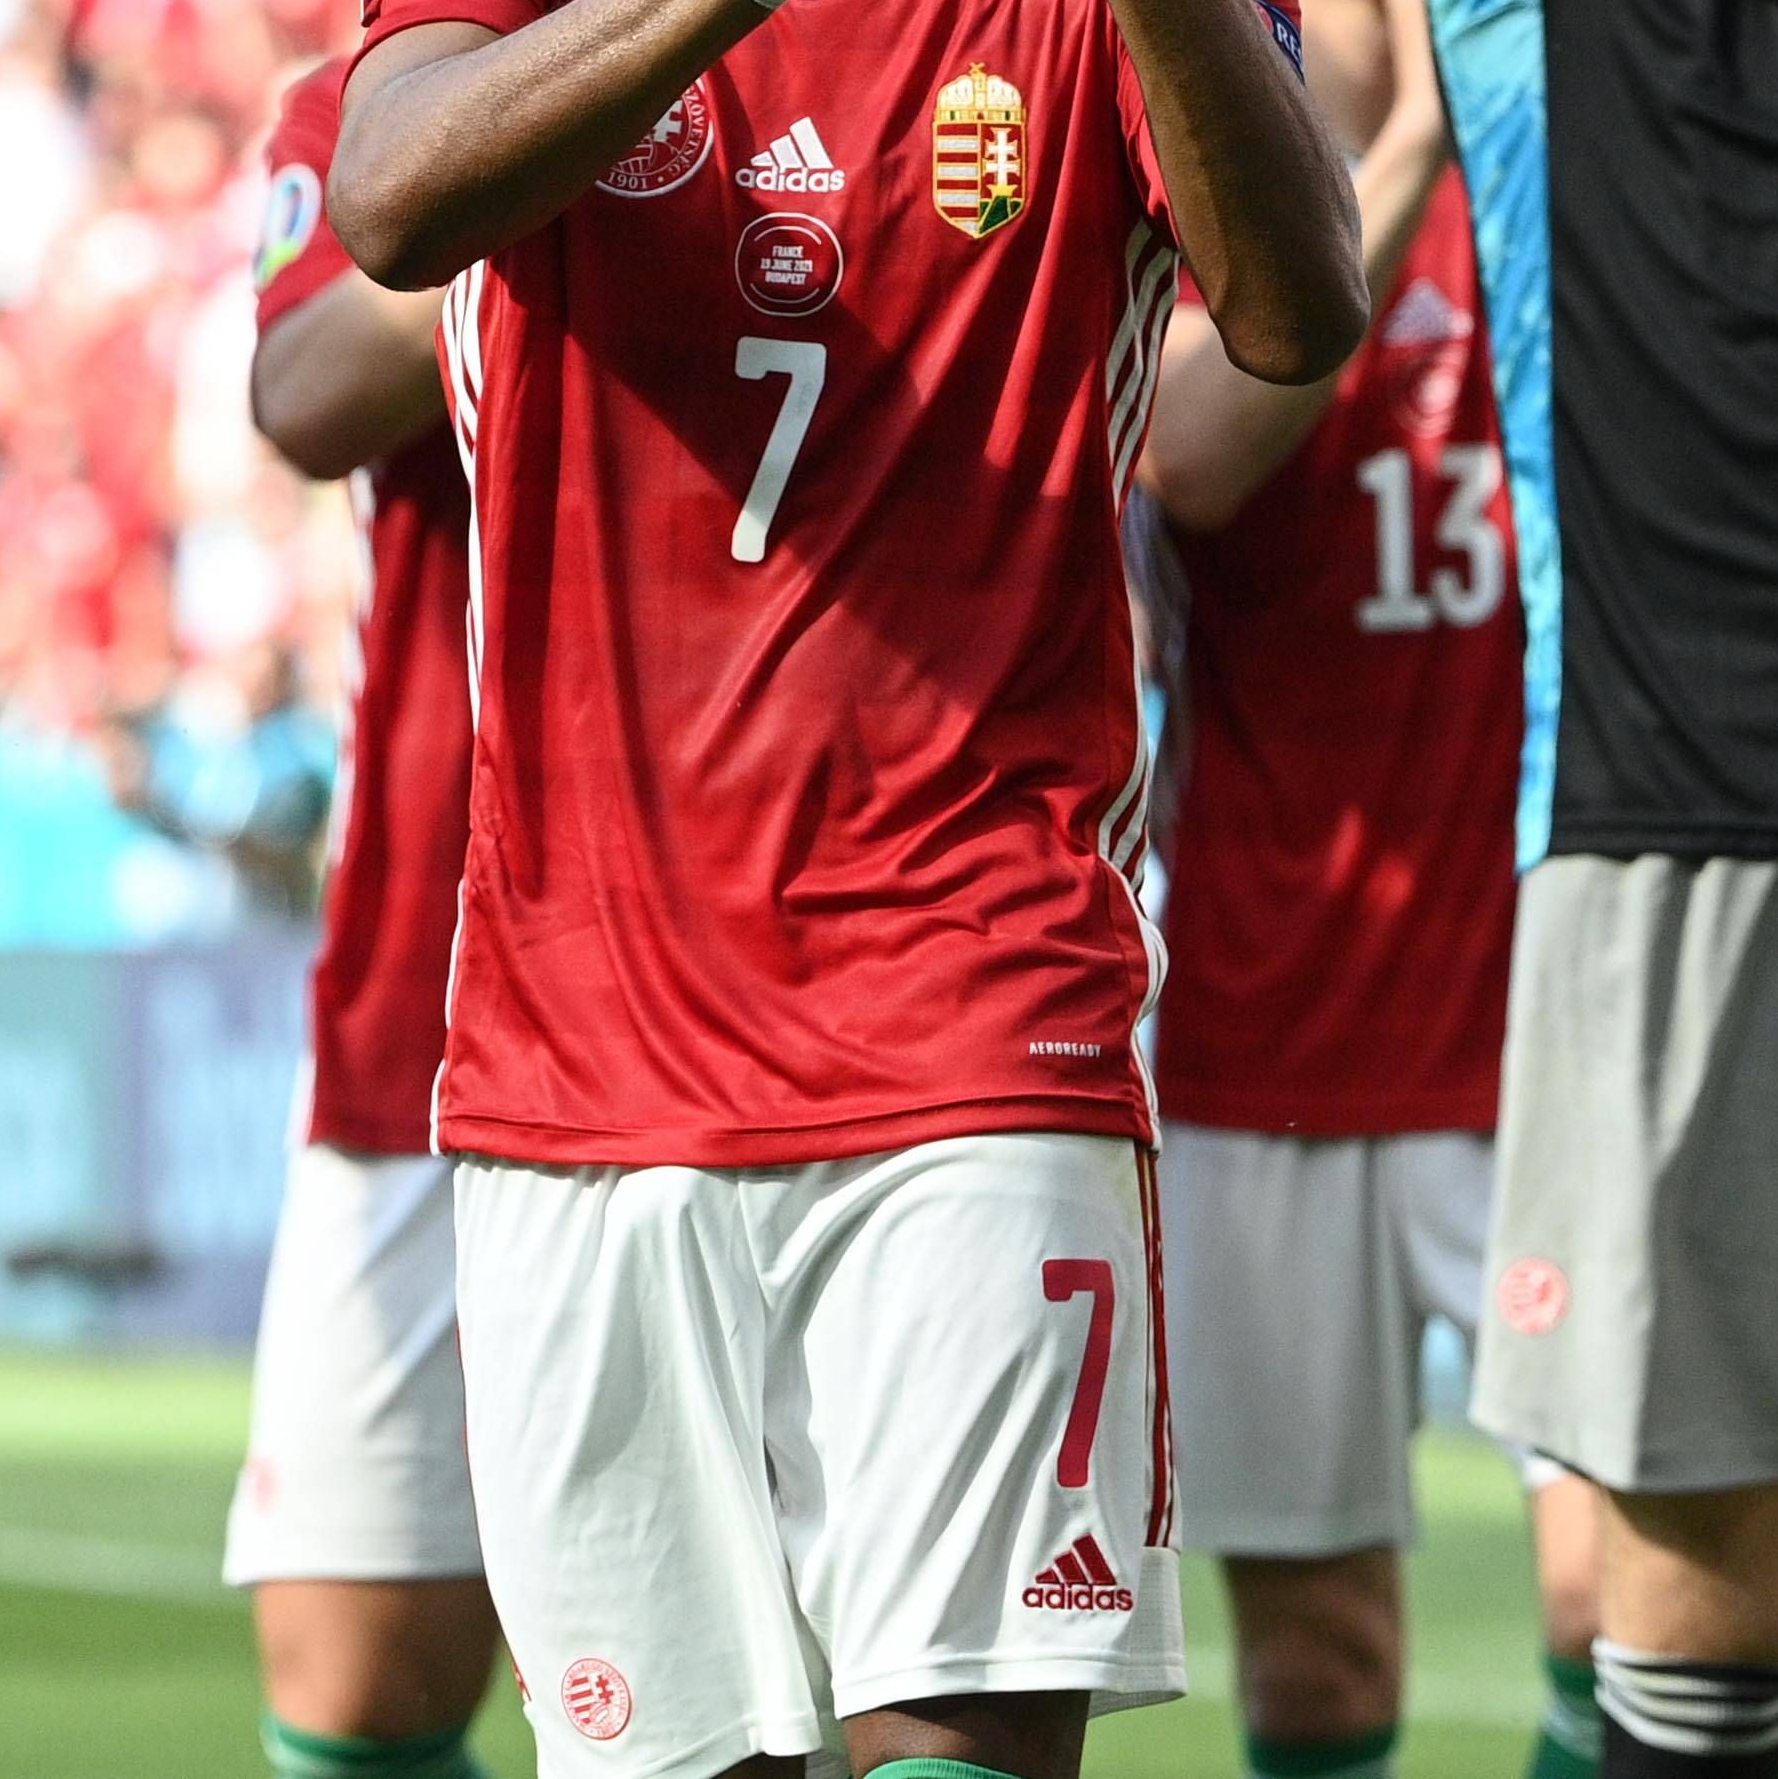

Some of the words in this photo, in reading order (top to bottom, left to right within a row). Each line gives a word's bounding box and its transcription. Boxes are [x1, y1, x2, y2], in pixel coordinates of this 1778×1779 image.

[735, 166, 846, 193] adidas
[772, 245, 804, 258] FRANCE
[765, 271, 807, 285] BUDAPEST
[772, 259, 792, 272] JUNE
[731, 336, 828, 563] 7
[1356, 440, 1506, 632] 13
[1029, 1041, 1102, 1058] AEROREADY
[1042, 1258, 1116, 1489] 7
[1022, 1583, 1134, 1612] adidas
